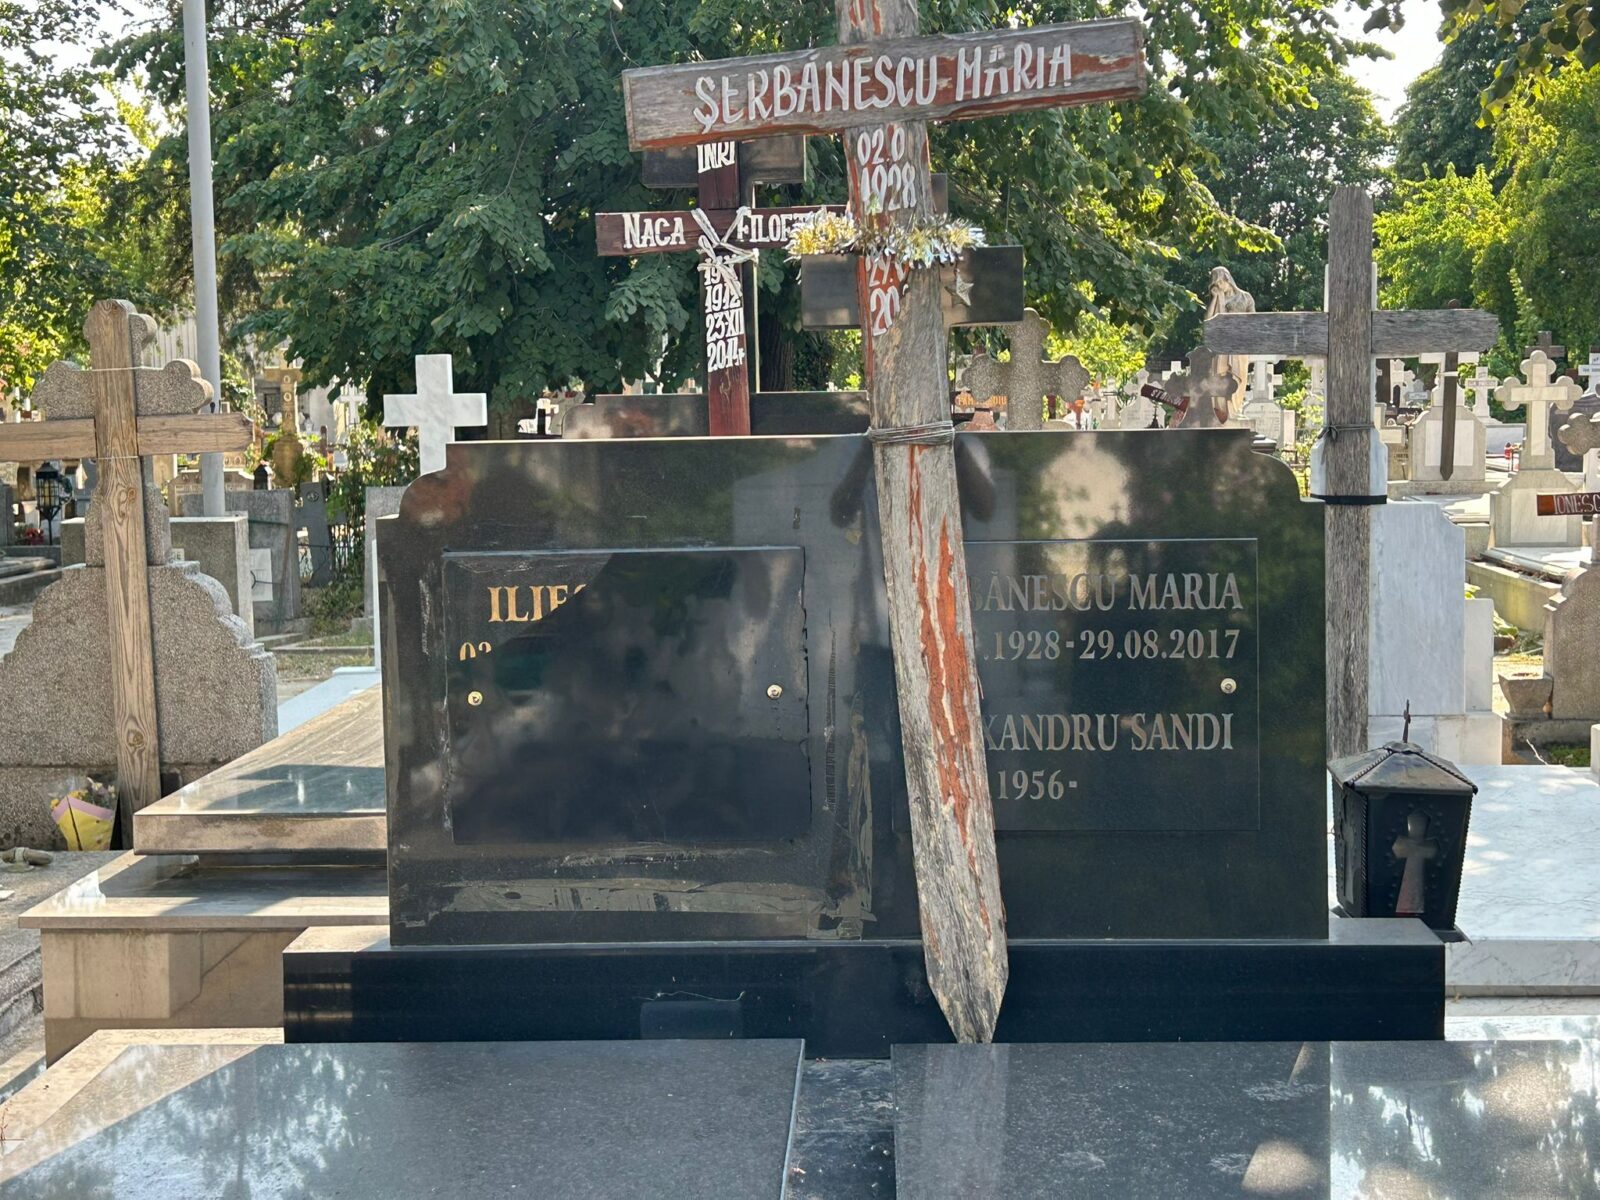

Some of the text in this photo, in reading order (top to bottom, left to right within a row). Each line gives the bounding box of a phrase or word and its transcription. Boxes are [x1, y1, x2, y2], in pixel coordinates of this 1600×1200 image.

[697, 140, 736, 174] INRI
[861, 160, 918, 215] 1928
[622, 213, 687, 249] NACA
[1127, 572, 1244, 611] MARIA
[974, 628, 1240, 661] .1928-29.08.2017
[1131, 712, 1234, 752] SANDI
